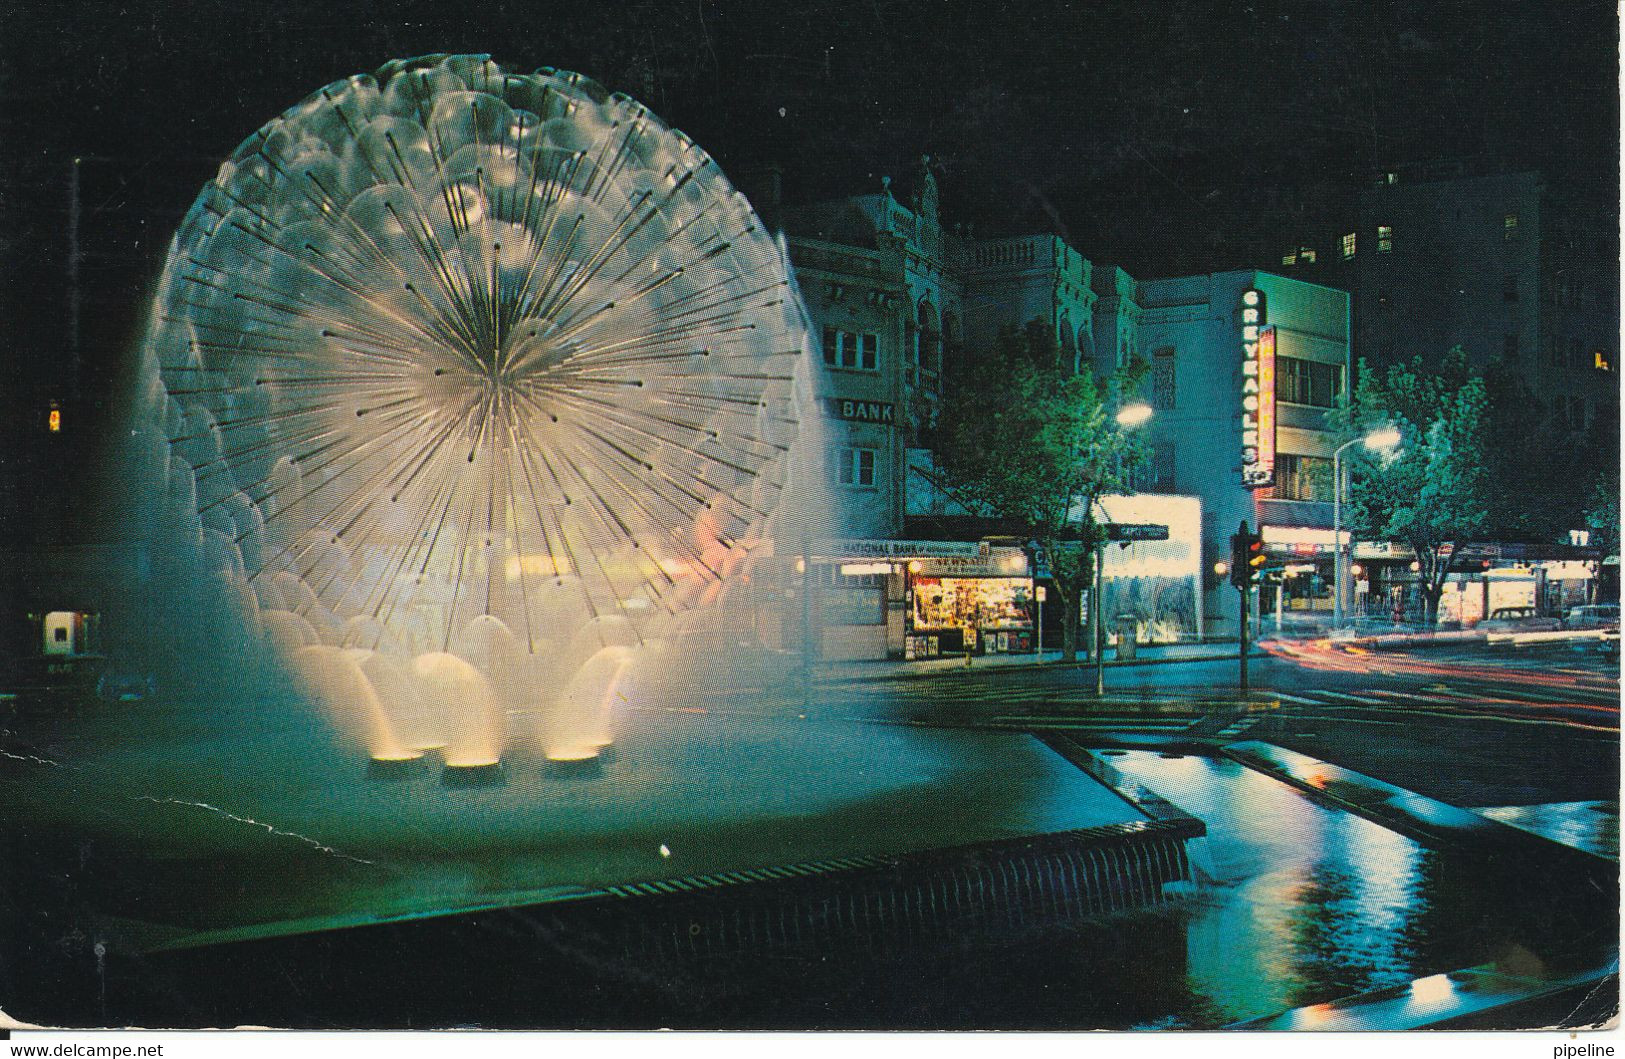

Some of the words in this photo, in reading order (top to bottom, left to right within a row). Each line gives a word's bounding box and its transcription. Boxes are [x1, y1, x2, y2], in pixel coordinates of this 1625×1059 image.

[1263, 344, 1273, 453] HOTEL
[843, 401, 893, 421] BANK
[893, 543, 917, 554] BANK
